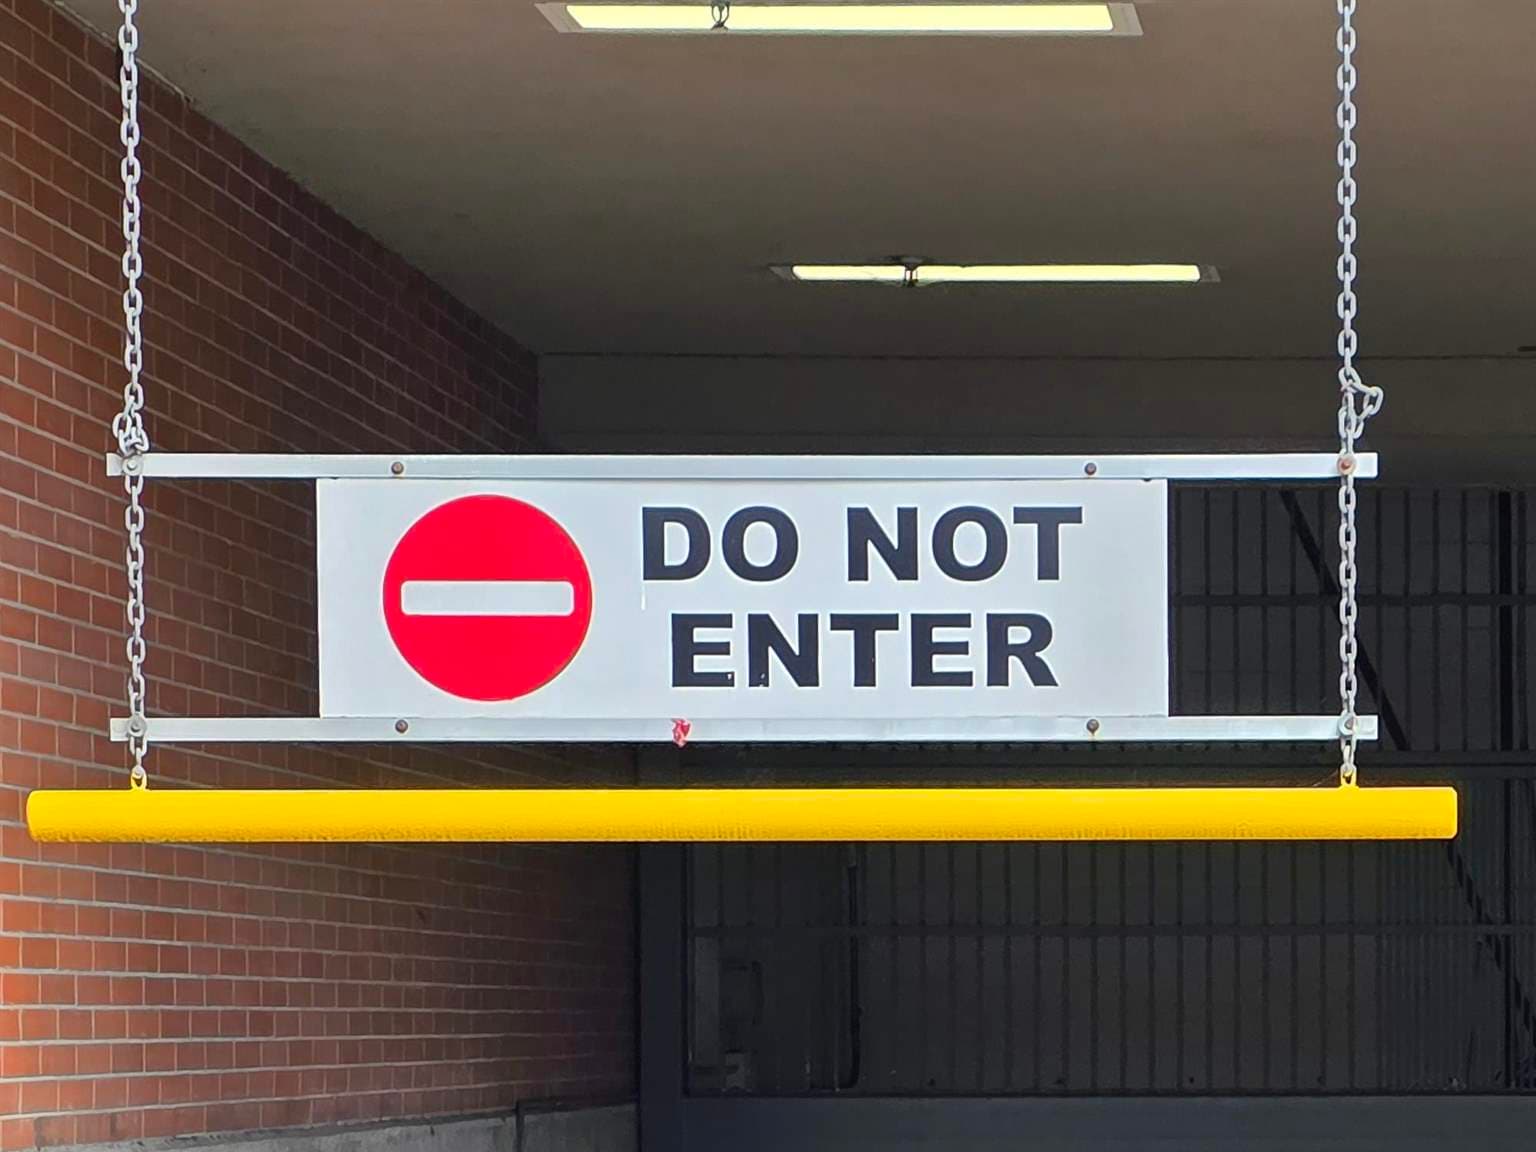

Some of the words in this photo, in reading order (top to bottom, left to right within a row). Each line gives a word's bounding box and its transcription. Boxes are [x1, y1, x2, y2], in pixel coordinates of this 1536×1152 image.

[643, 507, 798, 581] DO
[848, 507, 1082, 581] NOT
[672, 614, 1058, 687] ENTER
